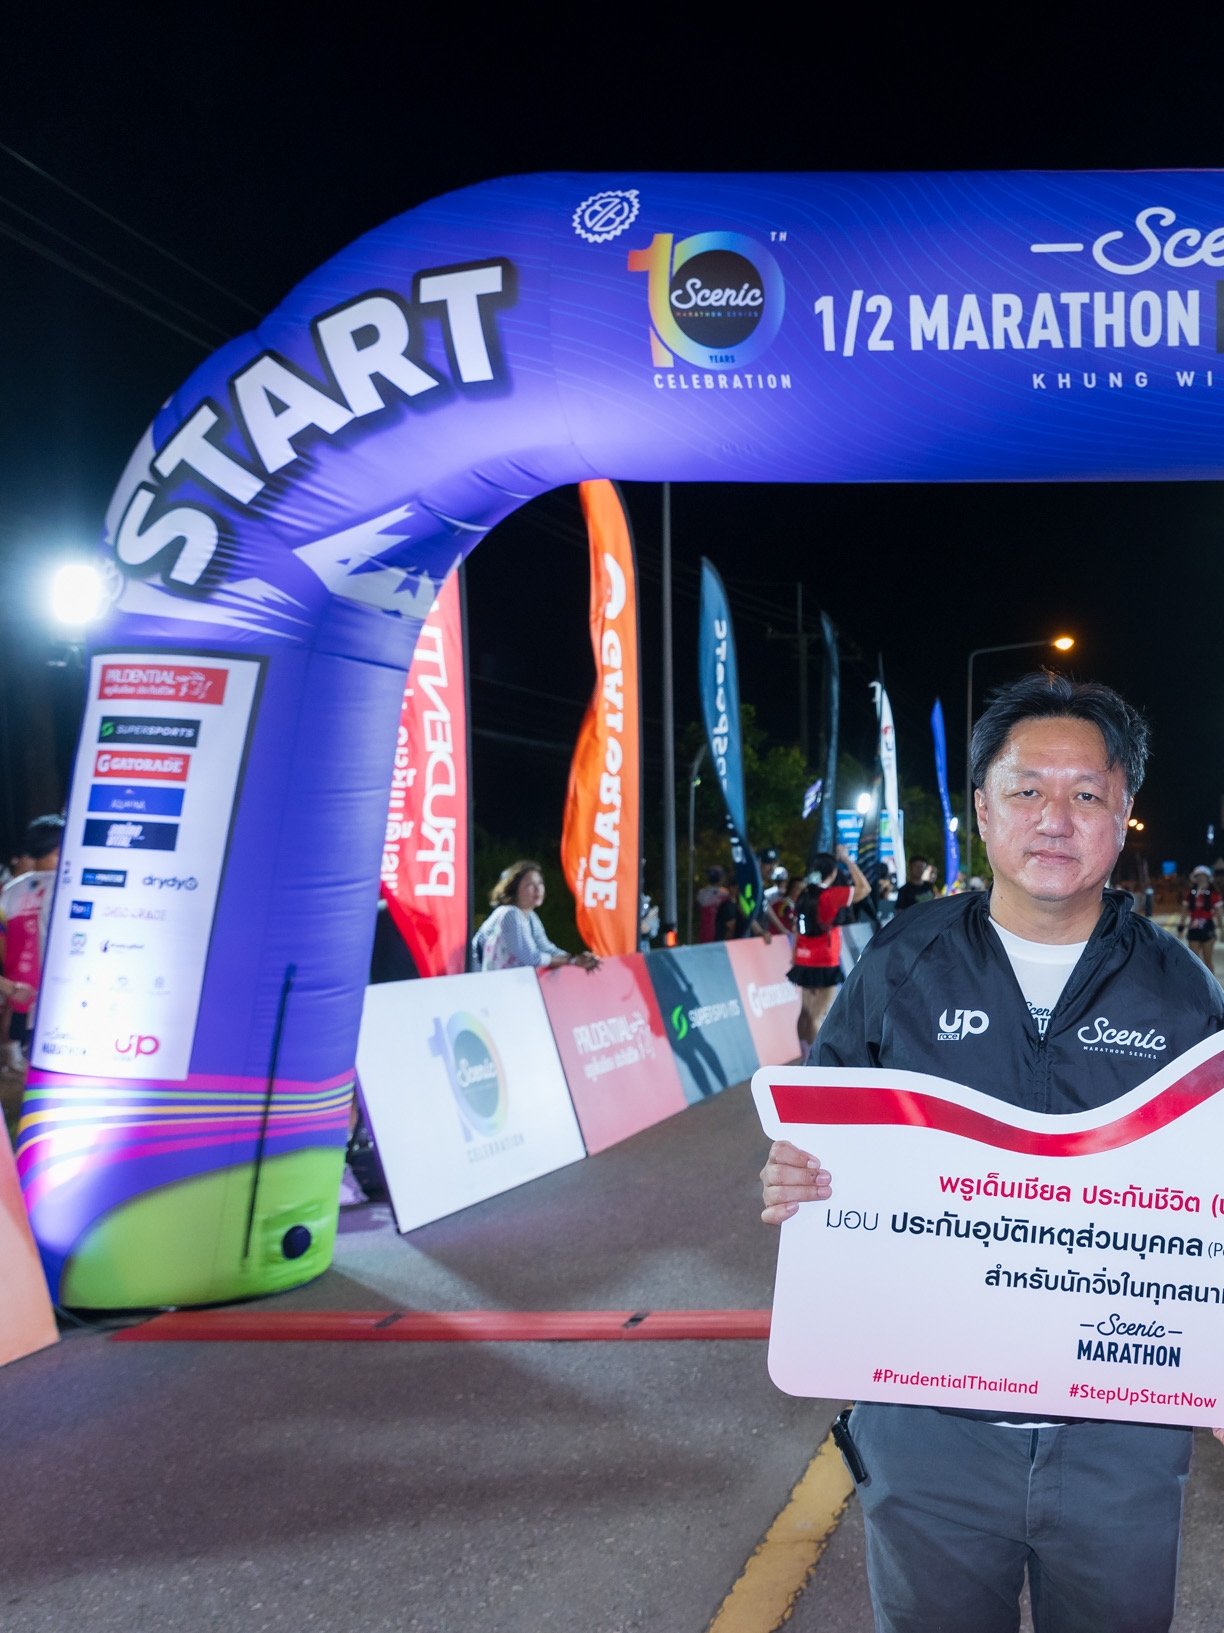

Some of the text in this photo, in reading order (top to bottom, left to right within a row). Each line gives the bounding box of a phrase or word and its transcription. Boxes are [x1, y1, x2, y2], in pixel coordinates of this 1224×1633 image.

[671, 278, 763, 309] Scenic
[814, 294, 894, 357] 1/2
[910, 289, 1200, 352] MARATHON
[709, 355, 735, 364] YEARS
[653, 373, 792, 389] CELEBRATION
[1031, 371, 1151, 390] KHUNG
[117, 266, 502, 586] START
[105, 669, 176, 684] PRUDENTIAL
[116, 725, 195, 738] SUPERSPORTS
[110, 757, 184, 773] GATORADE
[938, 1033, 959, 1041] race
[1077, 1017, 1167, 1051] Scenic
[1083, 1046, 1158, 1060] MARATHON SERIES
[456, 1057, 497, 1088] Scenic
[939, 1172, 1072, 1203] พรูเด็นเชียล
[1082, 1183, 1200, 1214] ประกันชีวิต
[826, 1207, 1203, 1260] มอบ ประกันอุบัติเหตุส่วนบุคคล
[1097, 1314, 1166, 1338] Scenic
[1077, 1340, 1181, 1368] MARATHON
[872, 1368, 1217, 1409] #PrudentialThailand #StepUpStartNow
